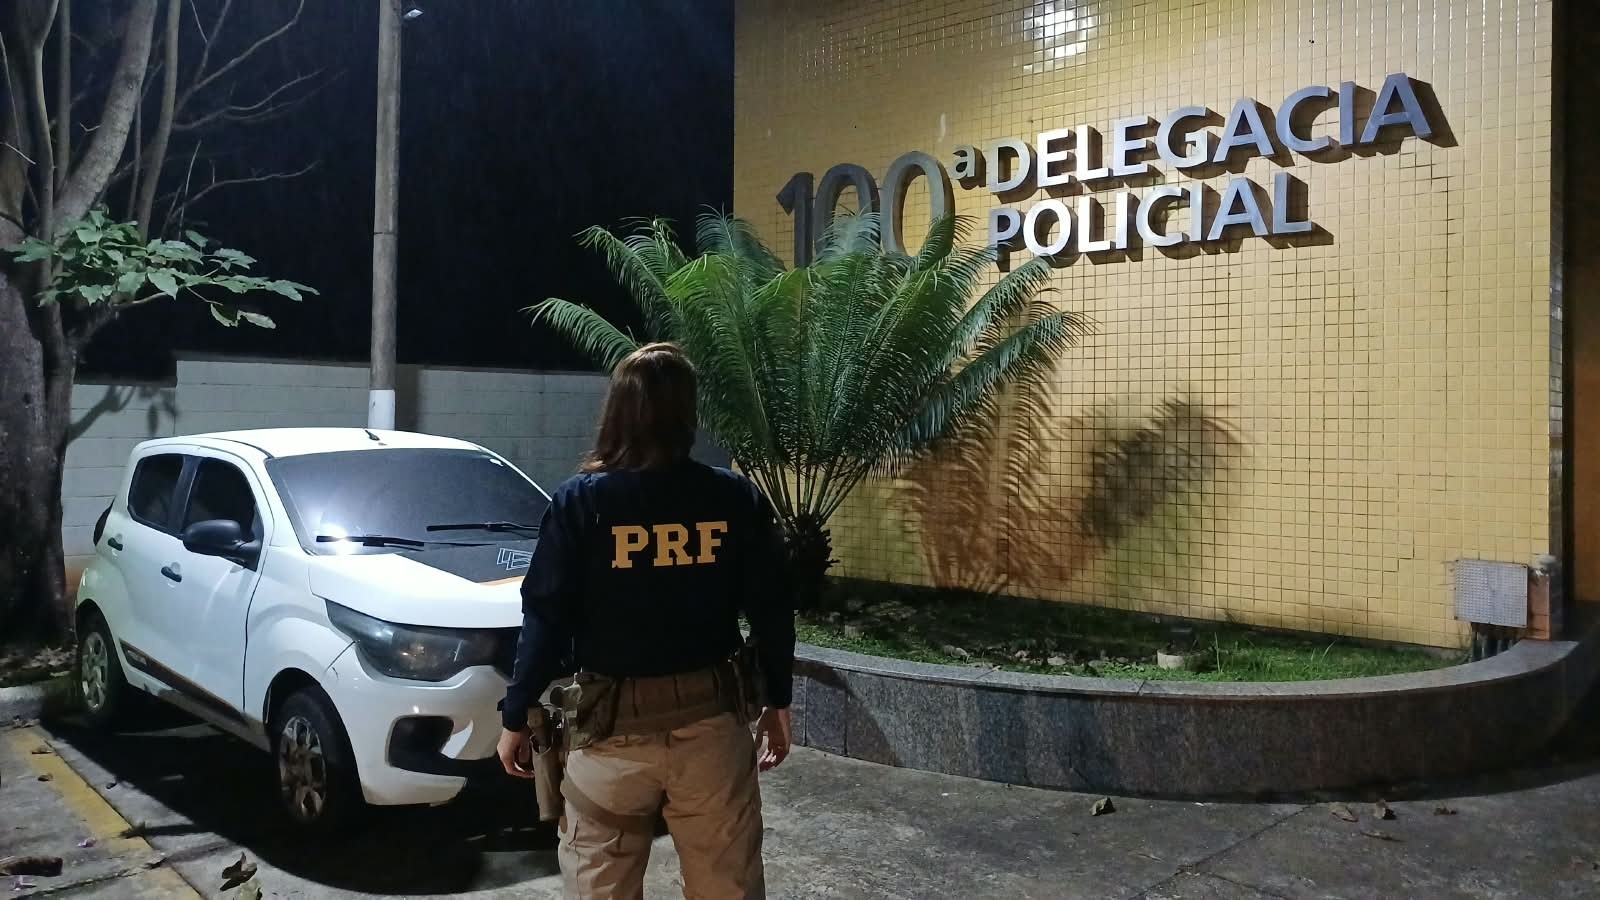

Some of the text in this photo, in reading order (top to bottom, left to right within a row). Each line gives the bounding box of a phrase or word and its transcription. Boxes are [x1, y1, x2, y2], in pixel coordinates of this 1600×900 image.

[988, 72, 1432, 194] DELEGACIA
[988, 172, 1312, 260] POLICIAL
[611, 521, 728, 568] PRF
